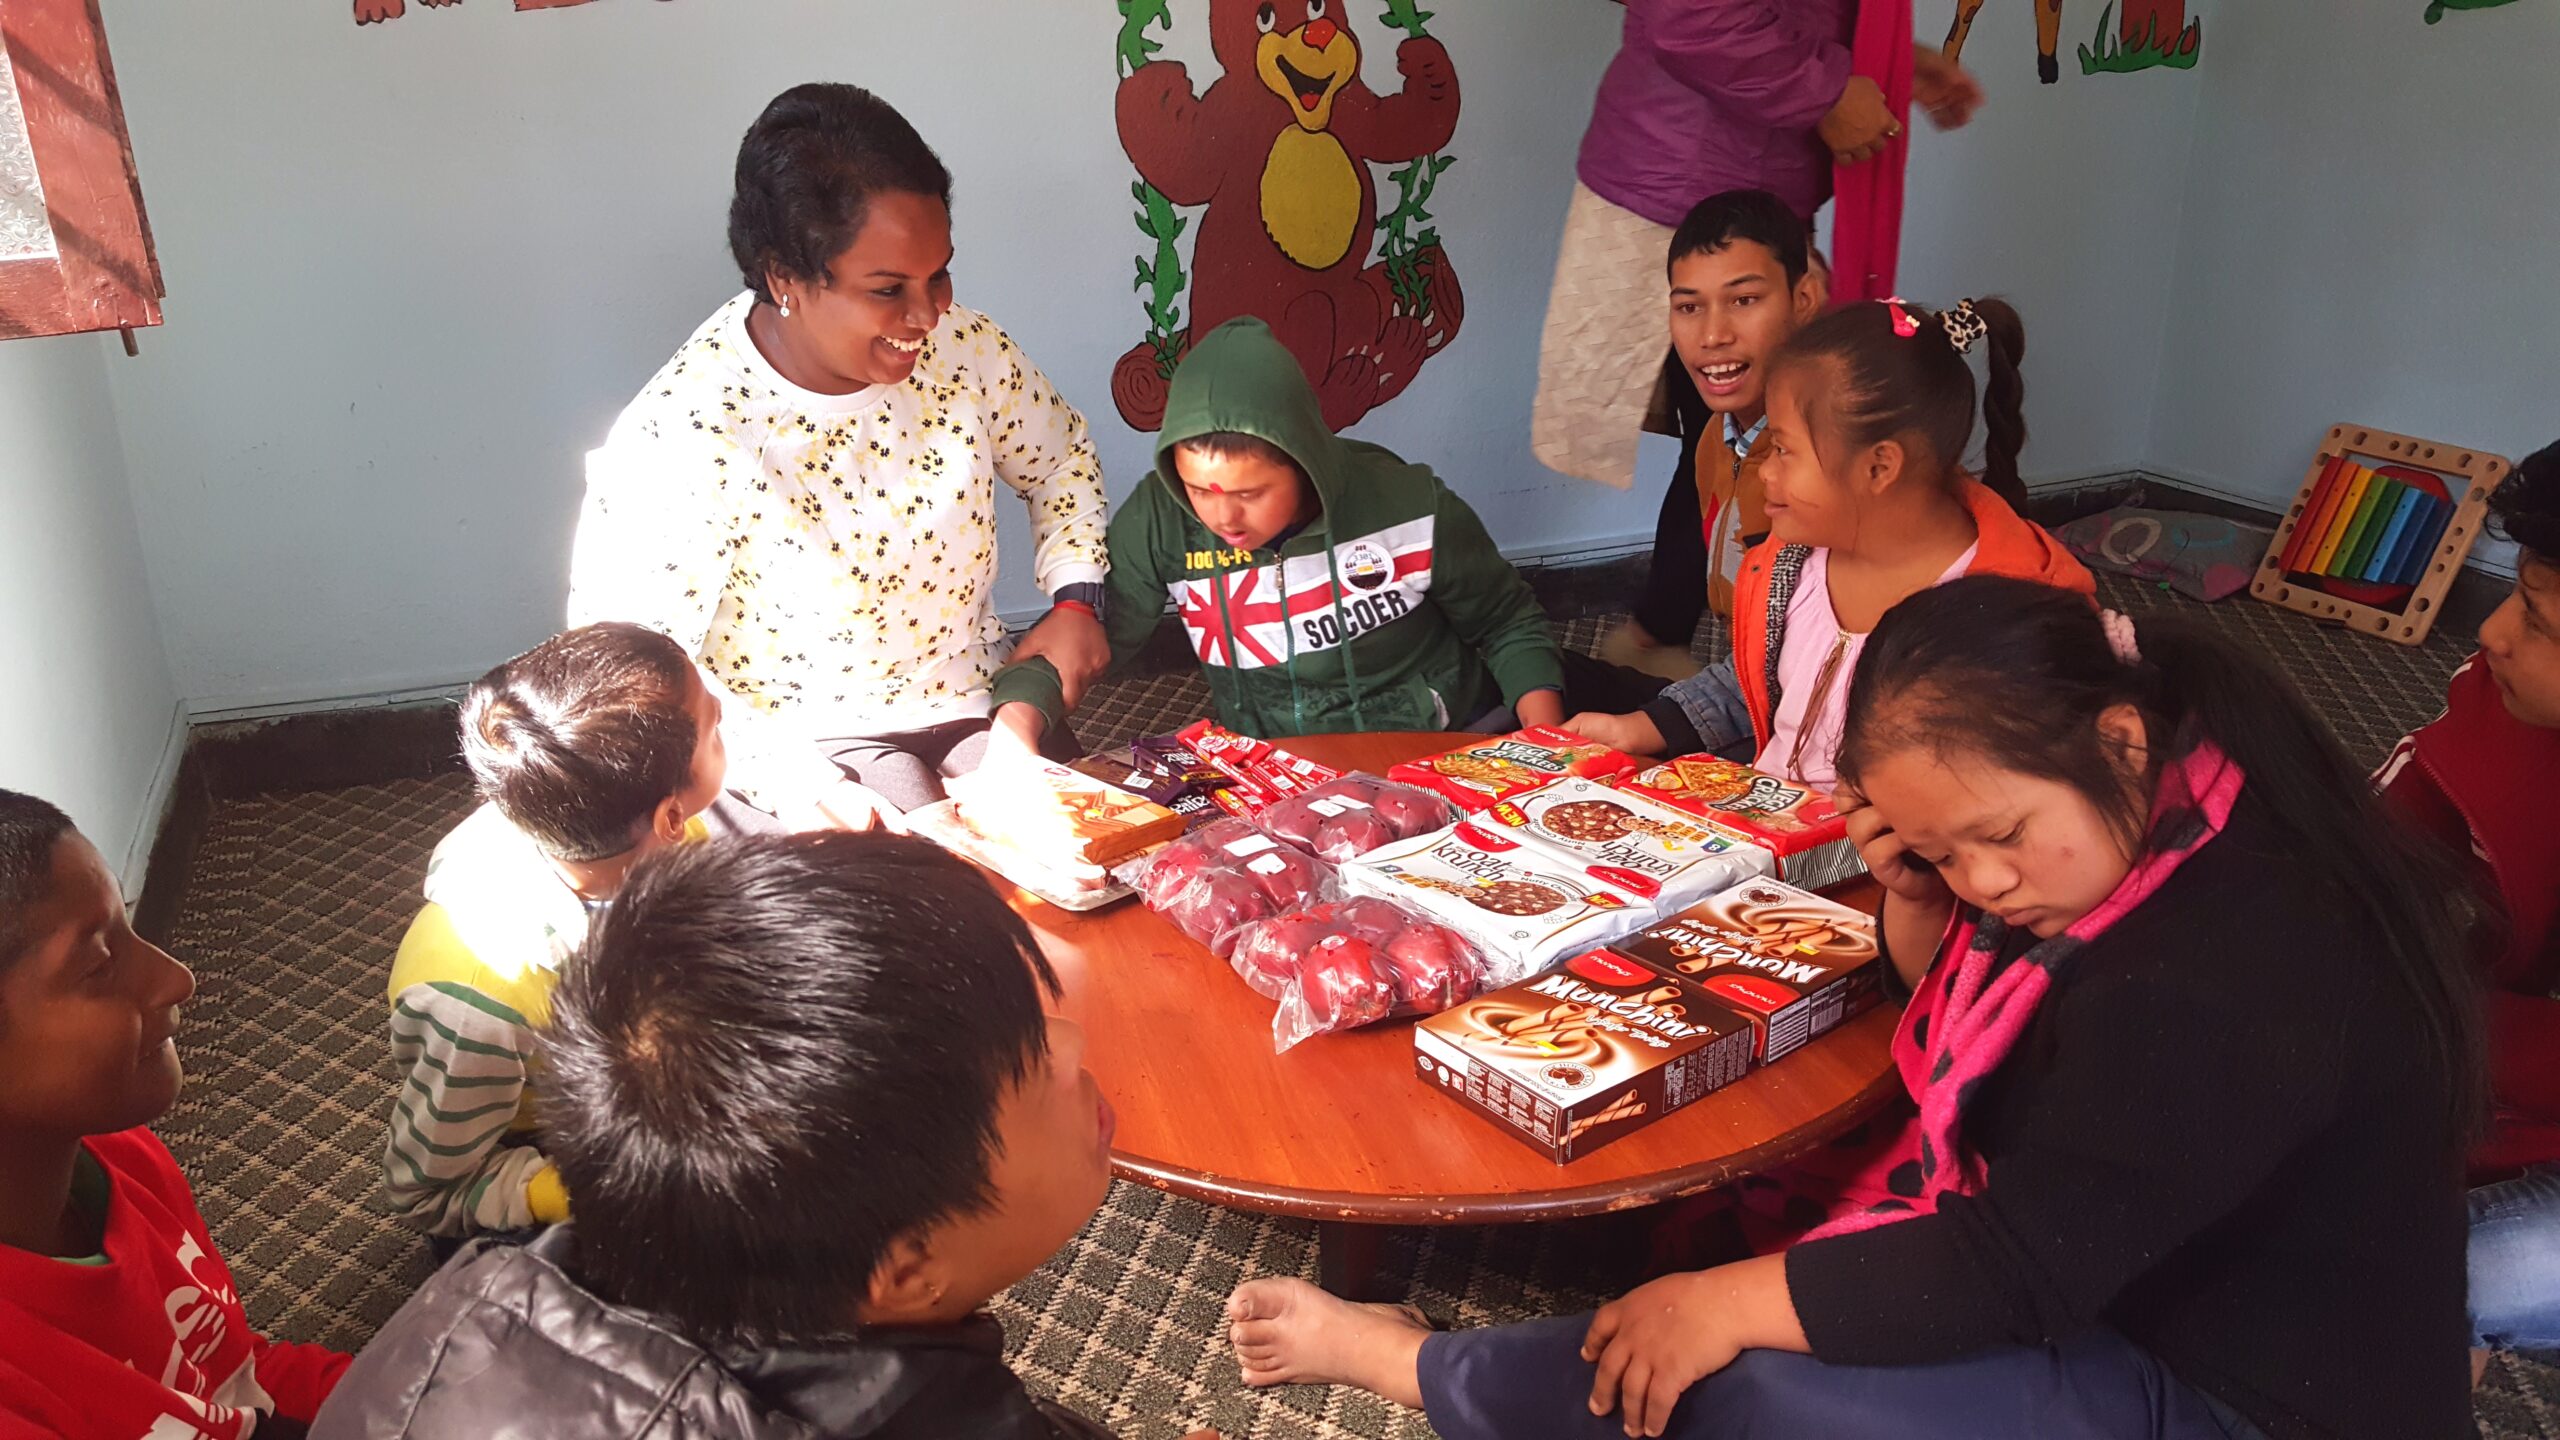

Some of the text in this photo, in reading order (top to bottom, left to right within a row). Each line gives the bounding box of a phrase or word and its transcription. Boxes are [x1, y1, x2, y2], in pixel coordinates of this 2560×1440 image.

[1185, 550, 1214, 570] 100
[1475, 749, 1563, 770] CRACKERS
[1500, 742, 1554, 758] VEGE
[1755, 787, 1801, 812] VEGE
[1494, 803, 1526, 827] NEW
[1431, 841, 1505, 881] krunch
[1467, 851, 1513, 871] oat
[1596, 851, 1642, 869] oat
[1601, 841, 1681, 876] krunch
[1649, 926, 1829, 984] Munchini
[1527, 973, 1710, 1038] Munchini
